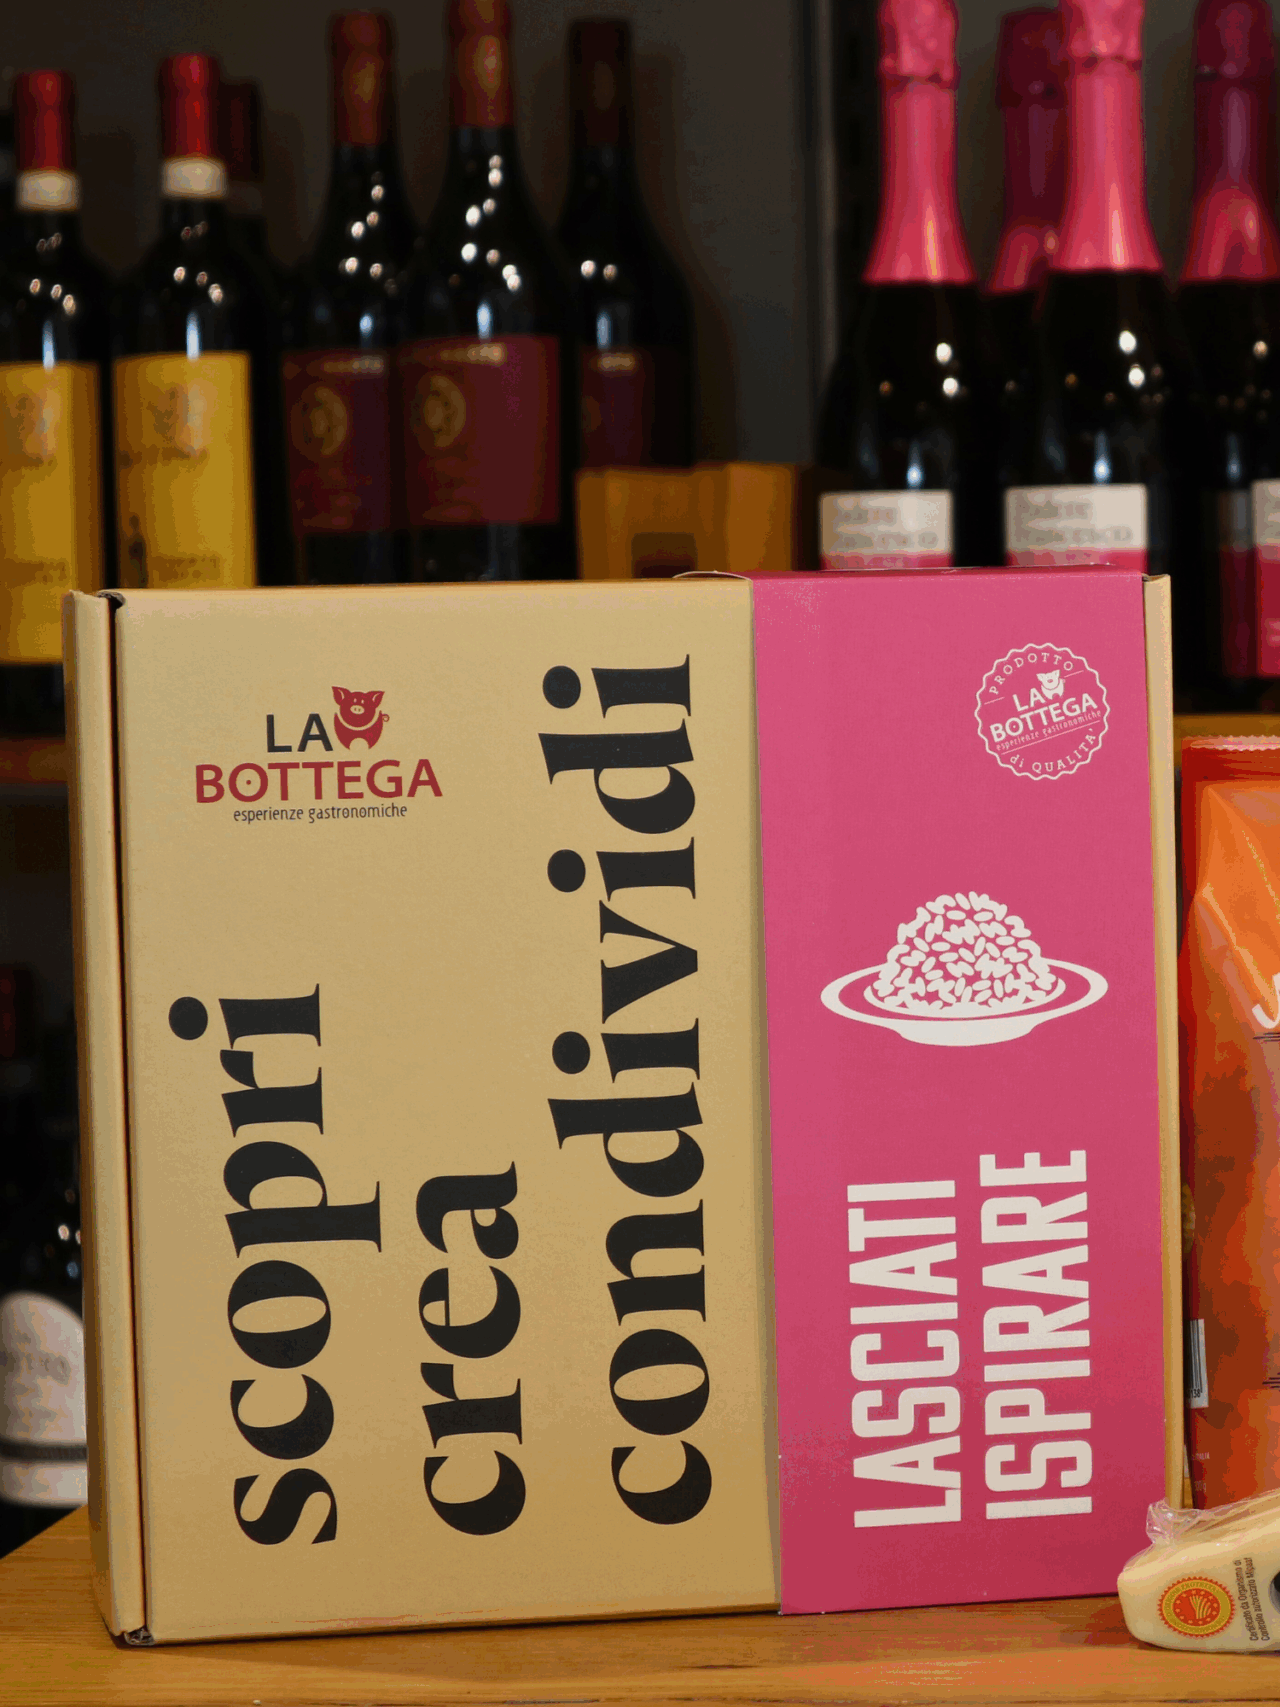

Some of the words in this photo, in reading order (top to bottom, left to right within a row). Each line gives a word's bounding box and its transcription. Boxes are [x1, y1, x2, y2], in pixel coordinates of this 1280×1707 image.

[989, 652, 1074, 695] PRODOTTO
[990, 693, 1098, 742] BOTTEGA
[1012, 688, 1046, 712] LA
[266, 713, 333, 753] LA
[996, 730, 1040, 751] esperienze
[1042, 710, 1101, 738] gastronomiche
[196, 759, 443, 803] BOTTEGA
[1010, 754, 1024, 768] di
[233, 807, 303, 825] esperienze
[308, 803, 408, 824] gastronomiche
[538, 653, 713, 1526] condividi
[168, 983, 382, 1545] scopri
[415, 1161, 526, 1536] crea
[847, 1180, 961, 1528] LASCIATI
[980, 1150, 1092, 1520] ISPIRARE
